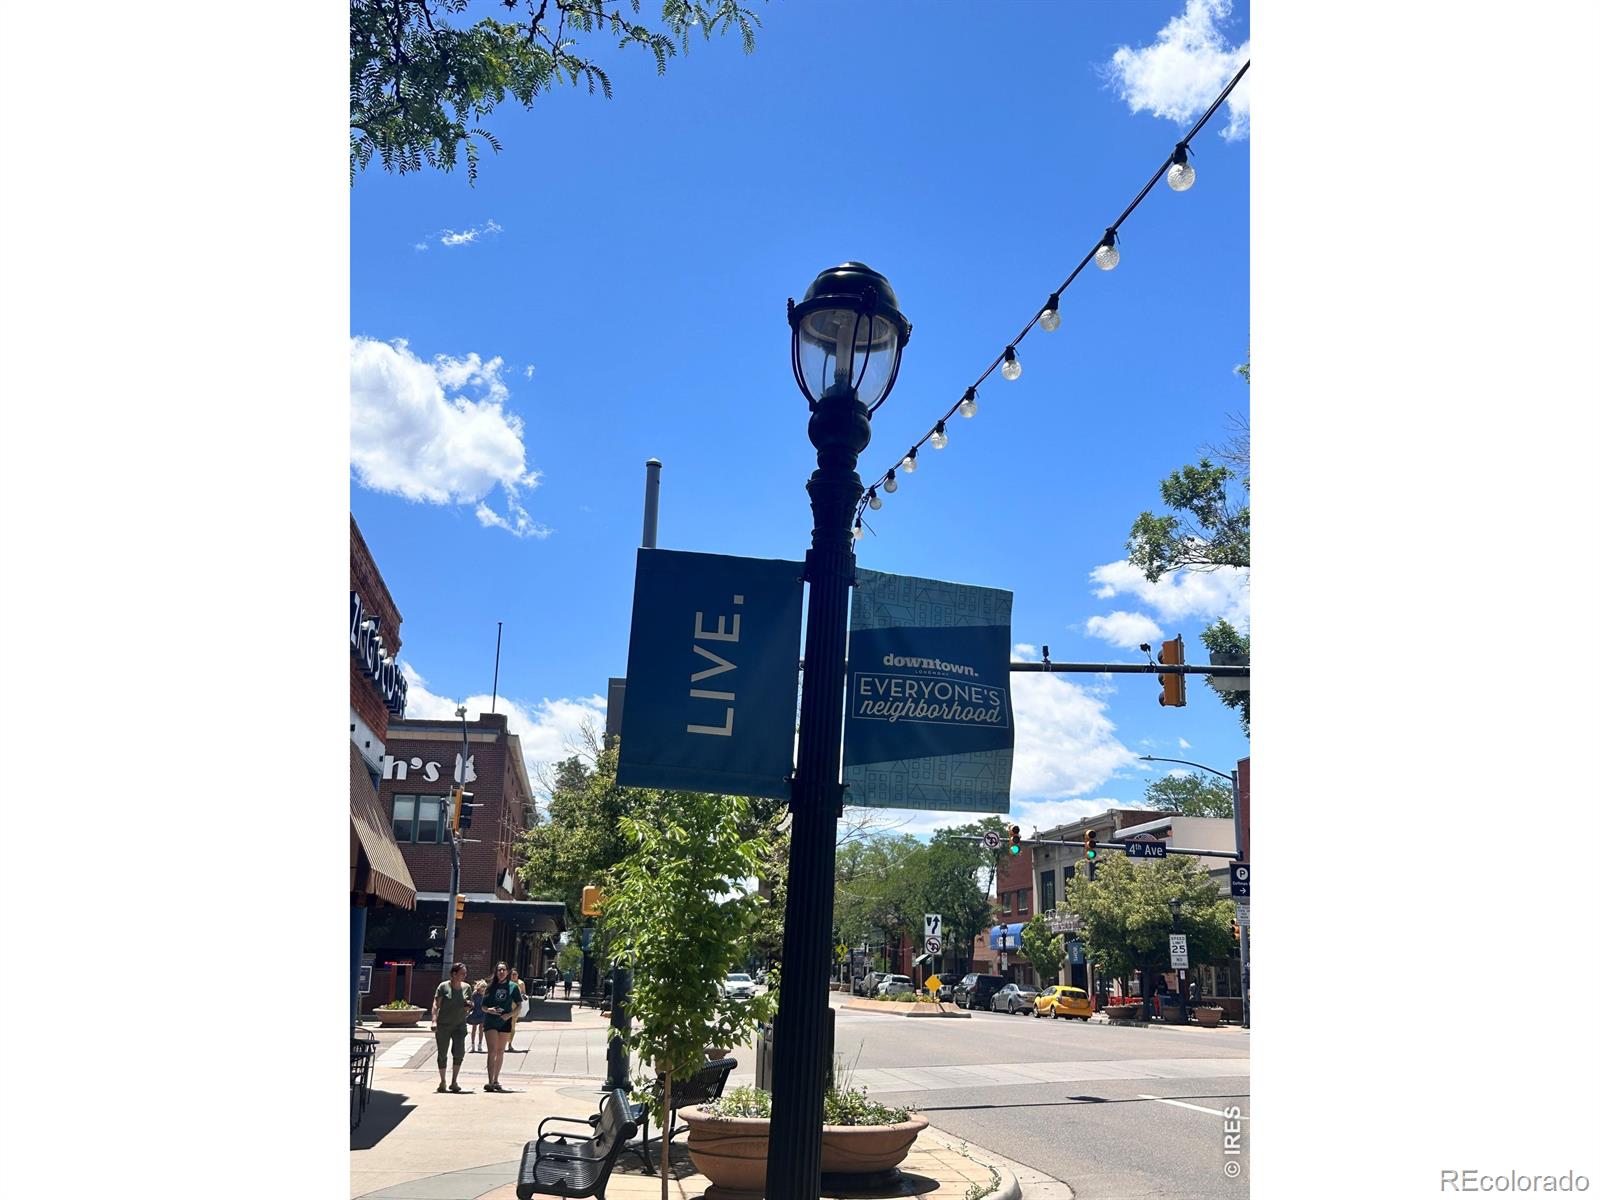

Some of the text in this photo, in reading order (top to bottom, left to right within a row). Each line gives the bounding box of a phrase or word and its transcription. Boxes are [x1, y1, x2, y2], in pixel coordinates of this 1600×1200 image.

[686, 594, 744, 737] LIVE.
[883, 653, 979, 677] downtown.
[859, 677, 1001, 706] EVERYONE'S
[859, 697, 1002, 723] neighborhood
[1129, 843, 1163, 856] 4th Ave
[1171, 945, 1186, 954] 25
